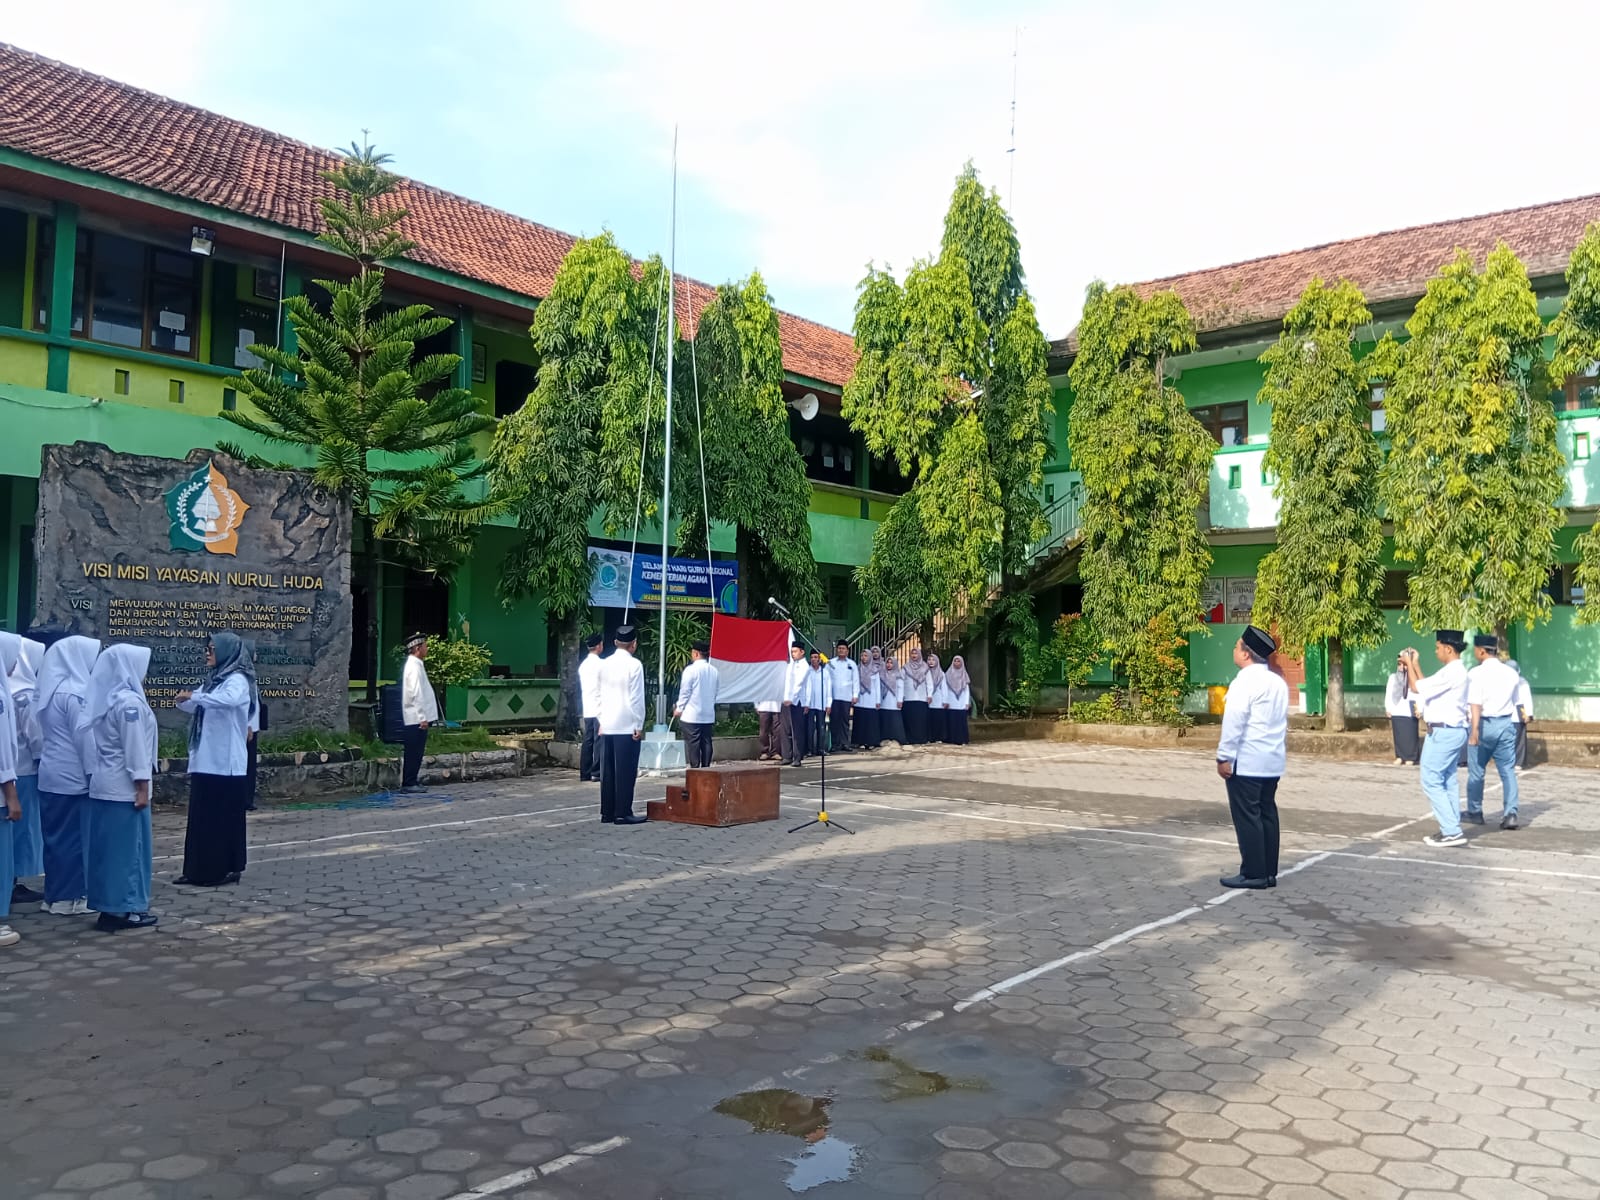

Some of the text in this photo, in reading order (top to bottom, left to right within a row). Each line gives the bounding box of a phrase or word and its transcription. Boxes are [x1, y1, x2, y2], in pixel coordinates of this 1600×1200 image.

[82, 562, 323, 590] VISI MISI YAYASAN NURUL HUDA
[641, 570, 687, 583] KEMETERIAN
[71, 600, 93, 610] VISI
[179, 602, 222, 611] LEMBAGA
[254, 604, 278, 613] YANG
[280, 606, 313, 615] UNGGUL
[109, 609, 130, 618] DAN
[251, 613, 274, 621] UMAT
[280, 615, 307, 623] UNTUK
[109, 619, 170, 627] MEMBANGUN
[178, 619, 198, 627] SDM
[201, 620, 227, 629] YANG
[109, 628, 130, 636] DAN
